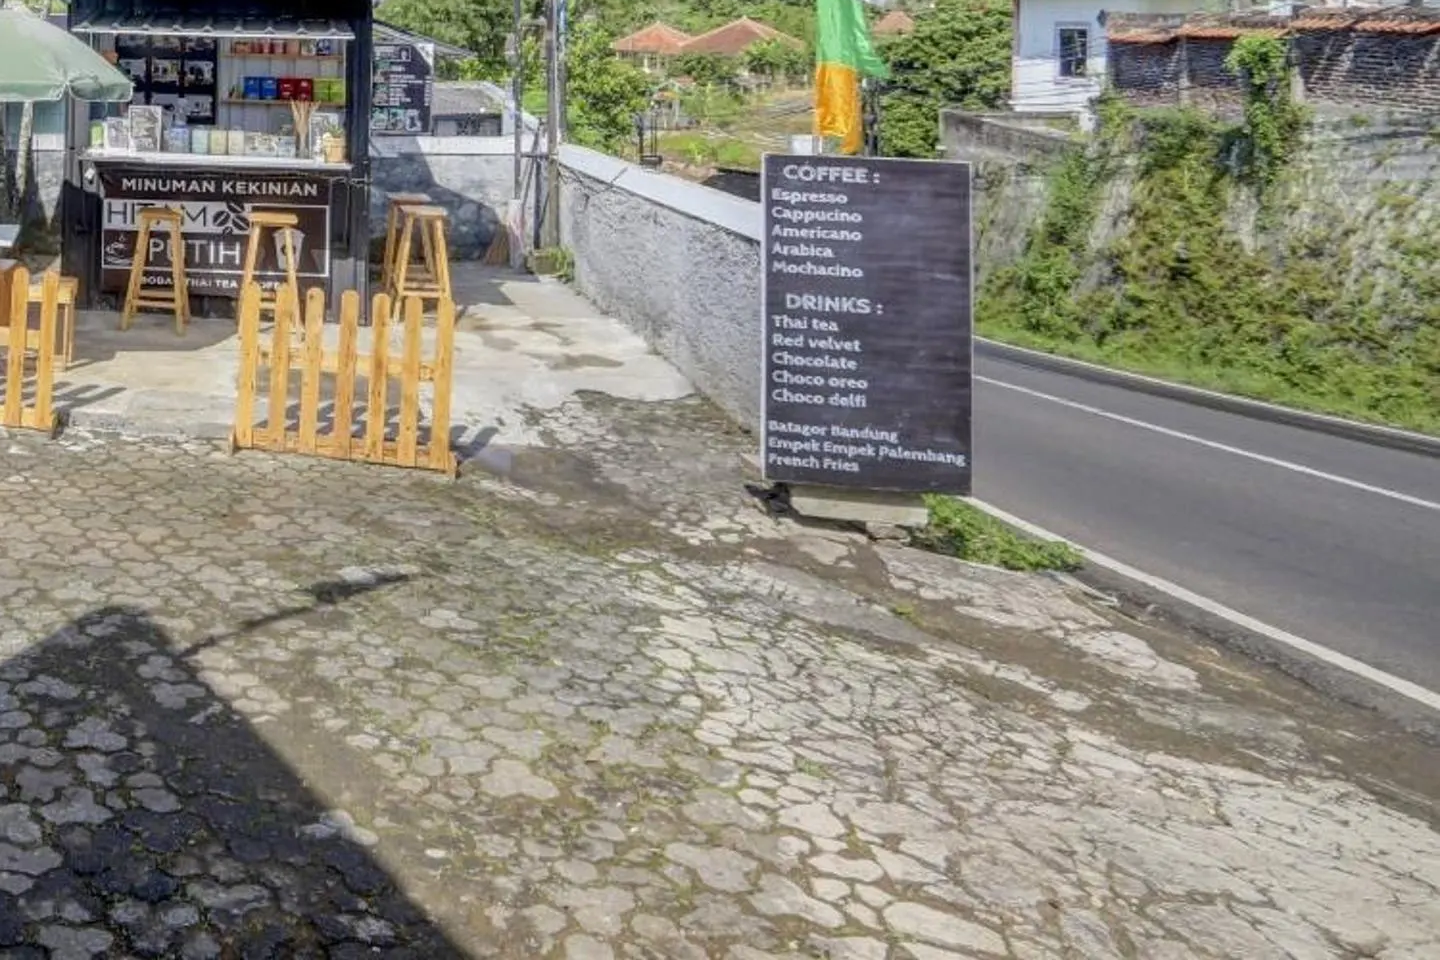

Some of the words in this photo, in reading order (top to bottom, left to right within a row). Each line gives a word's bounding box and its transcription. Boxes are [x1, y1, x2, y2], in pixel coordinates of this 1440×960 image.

[783, 164, 869, 183] COFFEE
[122, 178, 215, 192] MINUMAN
[222, 181, 318, 196] KEKINIAN
[771, 187, 848, 205] Espresso
[771, 206, 863, 223] Cappucino
[771, 224, 862, 241] Americano
[771, 242, 835, 258] Arabica
[771, 260, 864, 278] Mochacino
[216, 279, 238, 289] TEA
[786, 293, 871, 314] DRINKS
[772, 314, 808, 329] Thai
[812, 318, 839, 332] tea
[772, 333, 804, 348] Red
[808, 336, 862, 352] velvet
[772, 351, 858, 370] Chocolate
[772, 370, 825, 387] Choco
[828, 376, 868, 389] oreo
[772, 388, 825, 405] Choco
[768, 420, 827, 436] Batagor
[831, 425, 899, 444] Bandung
[768, 437, 820, 454] Empek
[823, 442, 876, 458] Empek
[879, 445, 966, 468] Palembang
[768, 454, 820, 469] French
[823, 458, 860, 472] Fries
